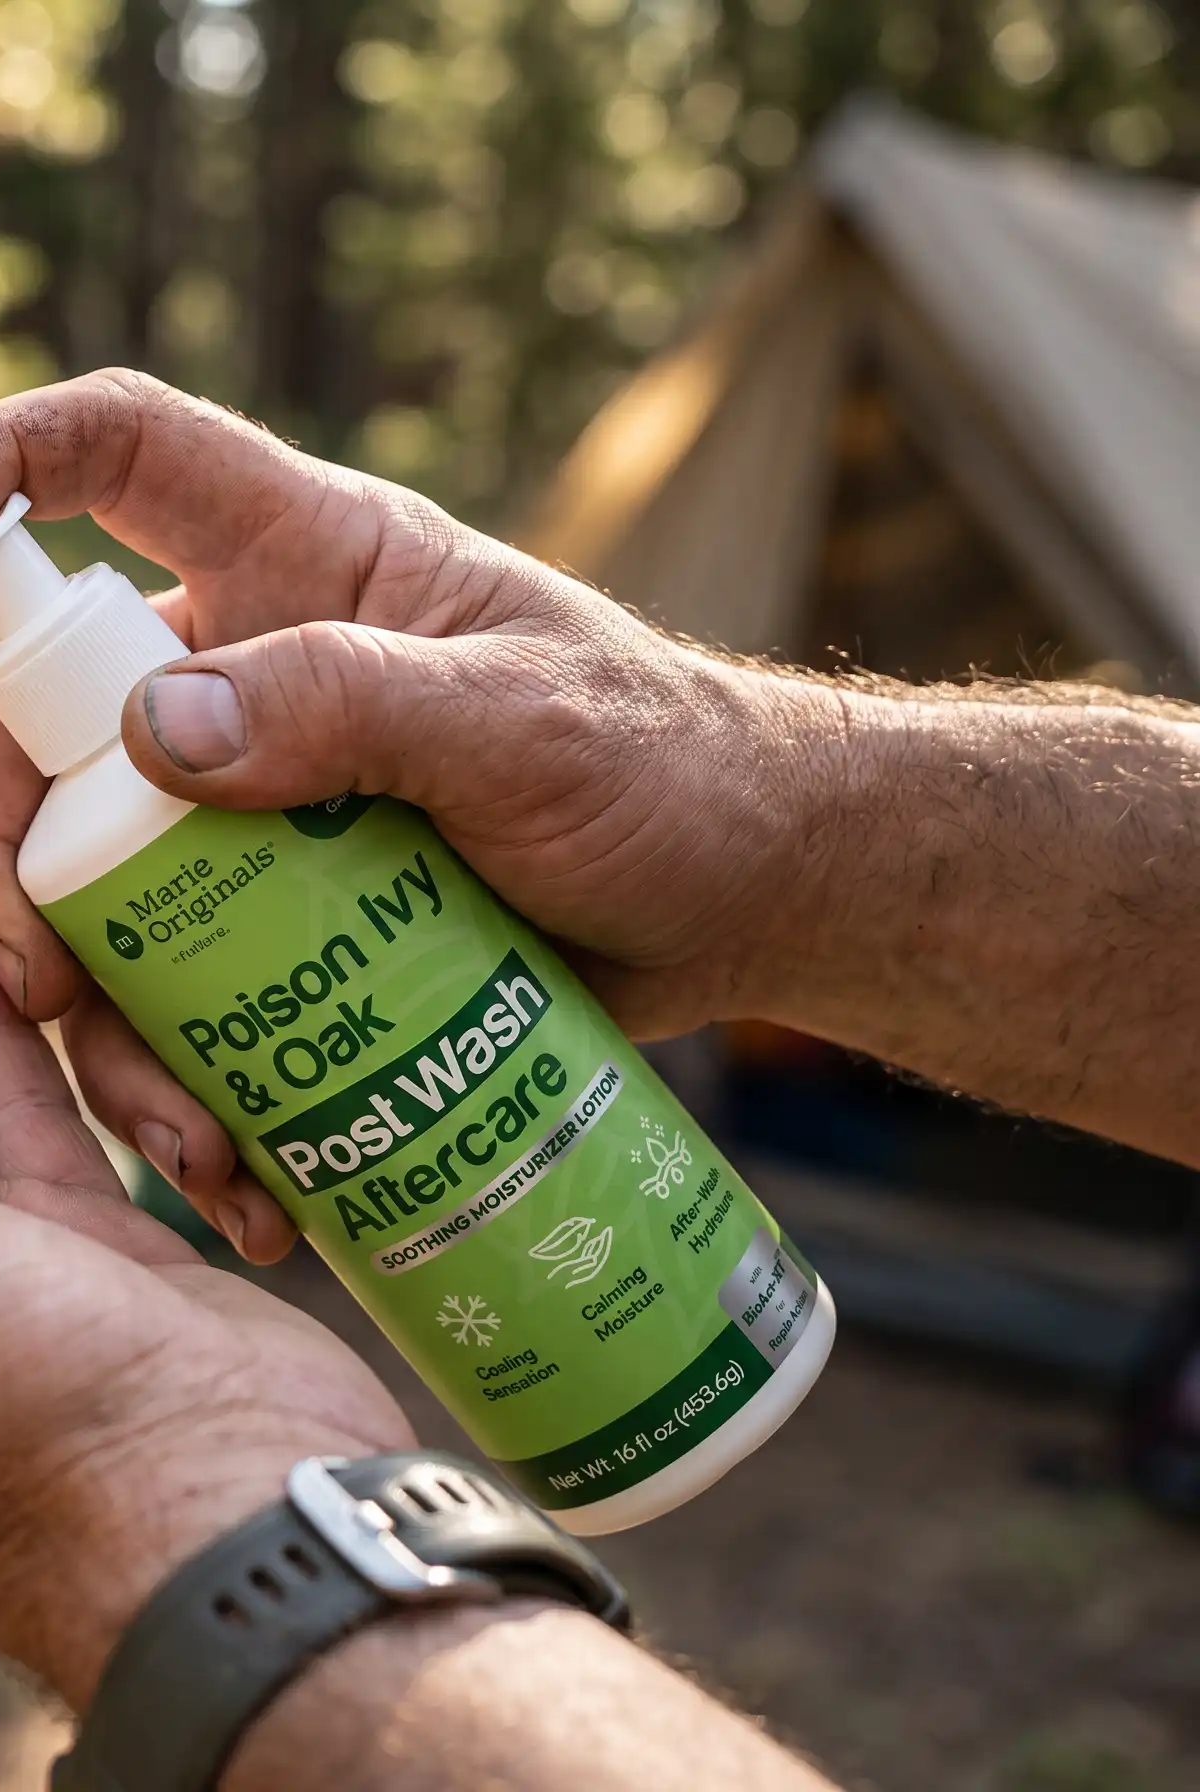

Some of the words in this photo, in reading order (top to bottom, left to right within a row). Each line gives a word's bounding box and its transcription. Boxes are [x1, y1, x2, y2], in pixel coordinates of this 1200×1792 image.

[126, 858, 213, 922] Marie
[179, 934, 369, 1068] Poison
[357, 851, 443, 944] Ivy
[225, 1069, 282, 1116] &
[273, 993, 396, 1089] Oak
[276, 1093, 415, 1188] Post
[394, 975, 544, 1113] Wash
[334, 1052, 567, 1241] Aftercare
[381, 1215, 470, 1269] SOOTHING
[468, 1120, 580, 1222] MOISTURIZER
[574, 1066, 620, 1127] LOTION
[581, 1266, 647, 1321] Calming
[594, 1282, 665, 1342] Moisture
[483, 1362, 560, 1402] Sensation
[548, 1470, 585, 1491] Net
[580, 1457, 616, 1480] Wt.
[613, 1442, 637, 1464] 16
[635, 1432, 653, 1452] fl
[654, 1419, 678, 1441] oz
[674, 1359, 745, 1427] (453.6g)
